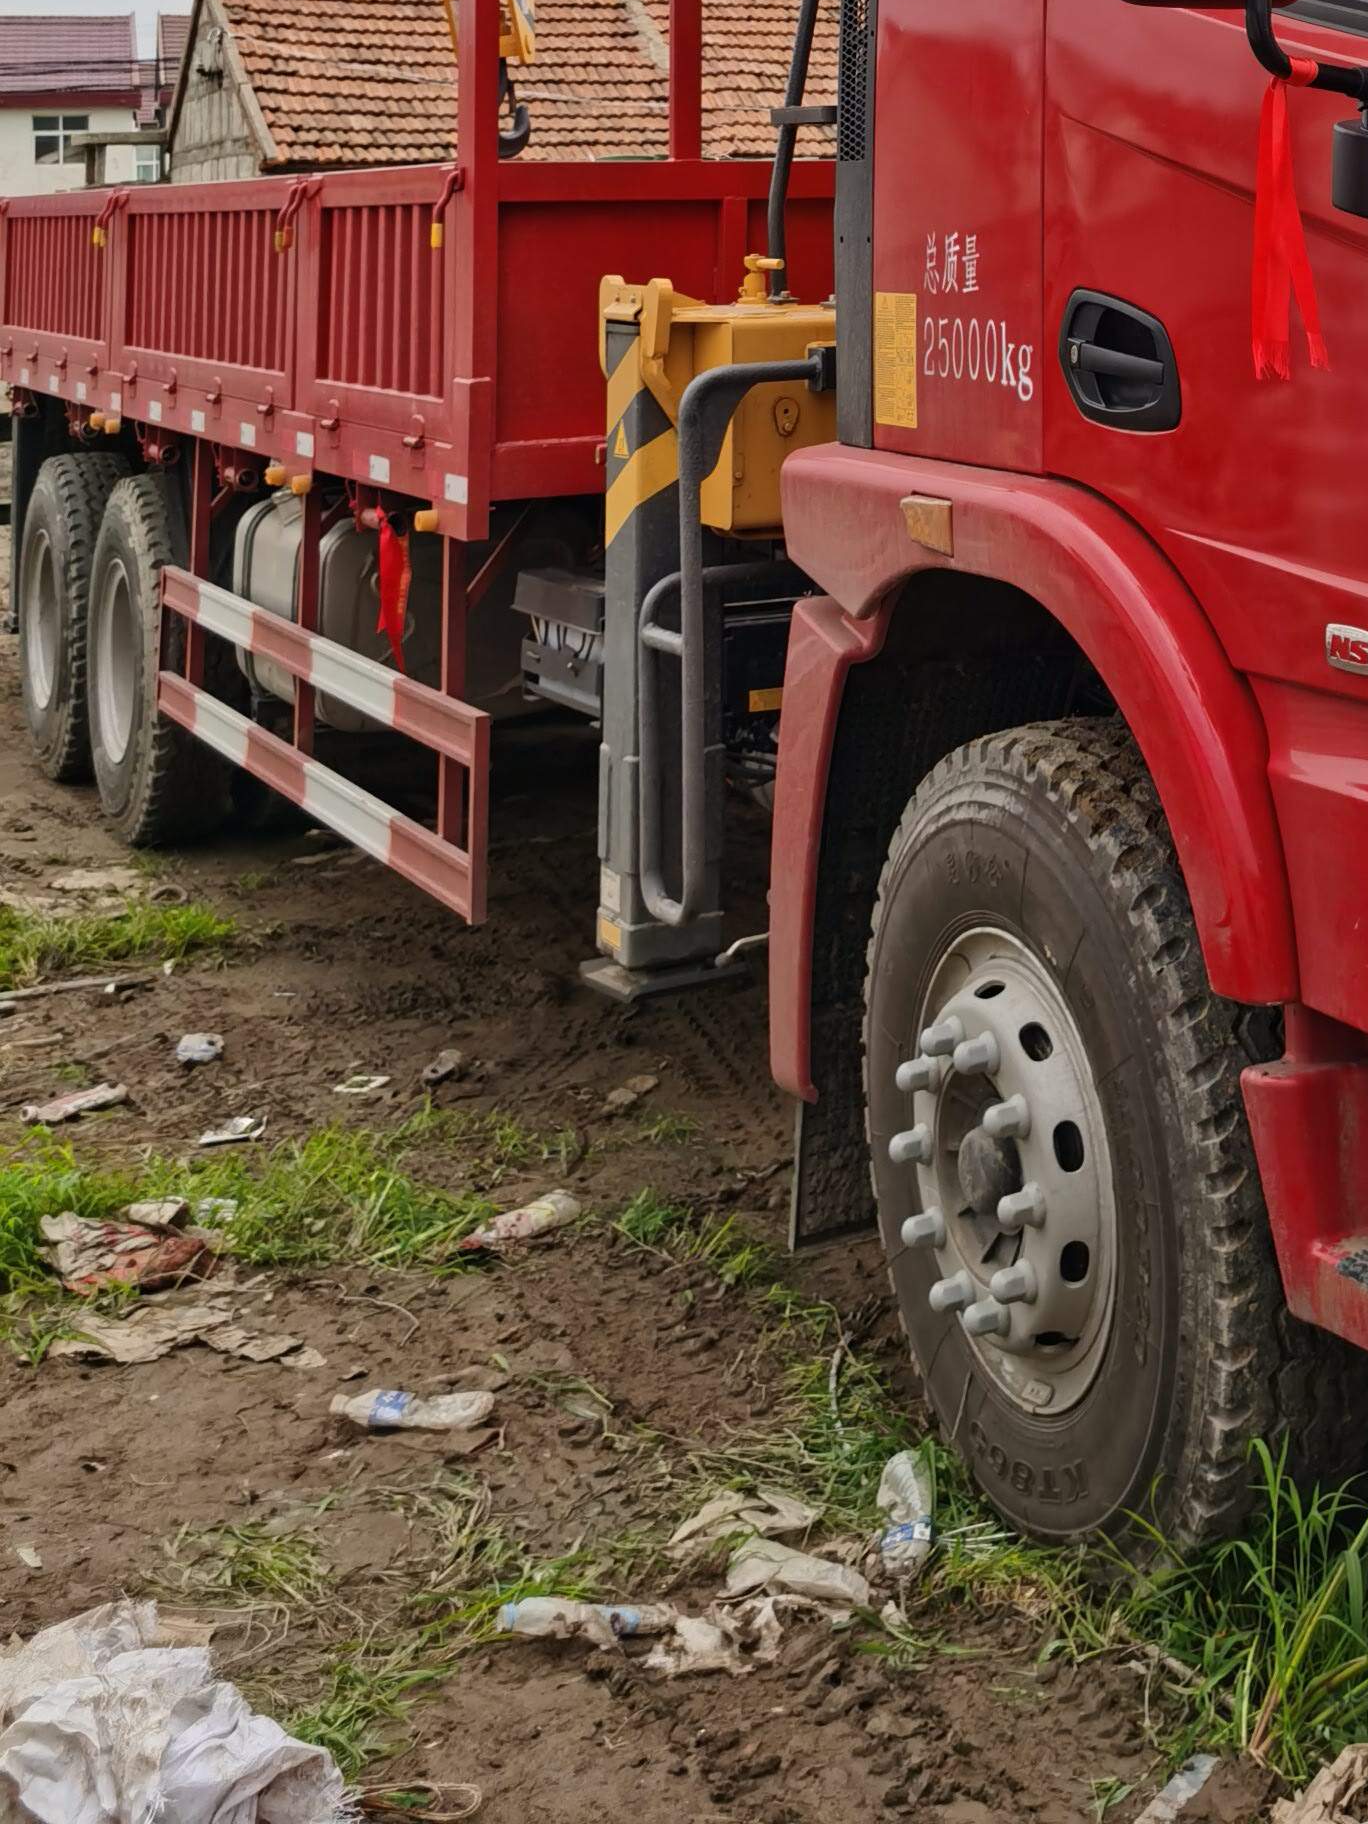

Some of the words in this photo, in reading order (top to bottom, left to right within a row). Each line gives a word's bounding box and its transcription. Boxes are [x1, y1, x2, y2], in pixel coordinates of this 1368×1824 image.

[923, 231, 980, 295] 总质量
[923, 316, 1035, 402] 25000kg
